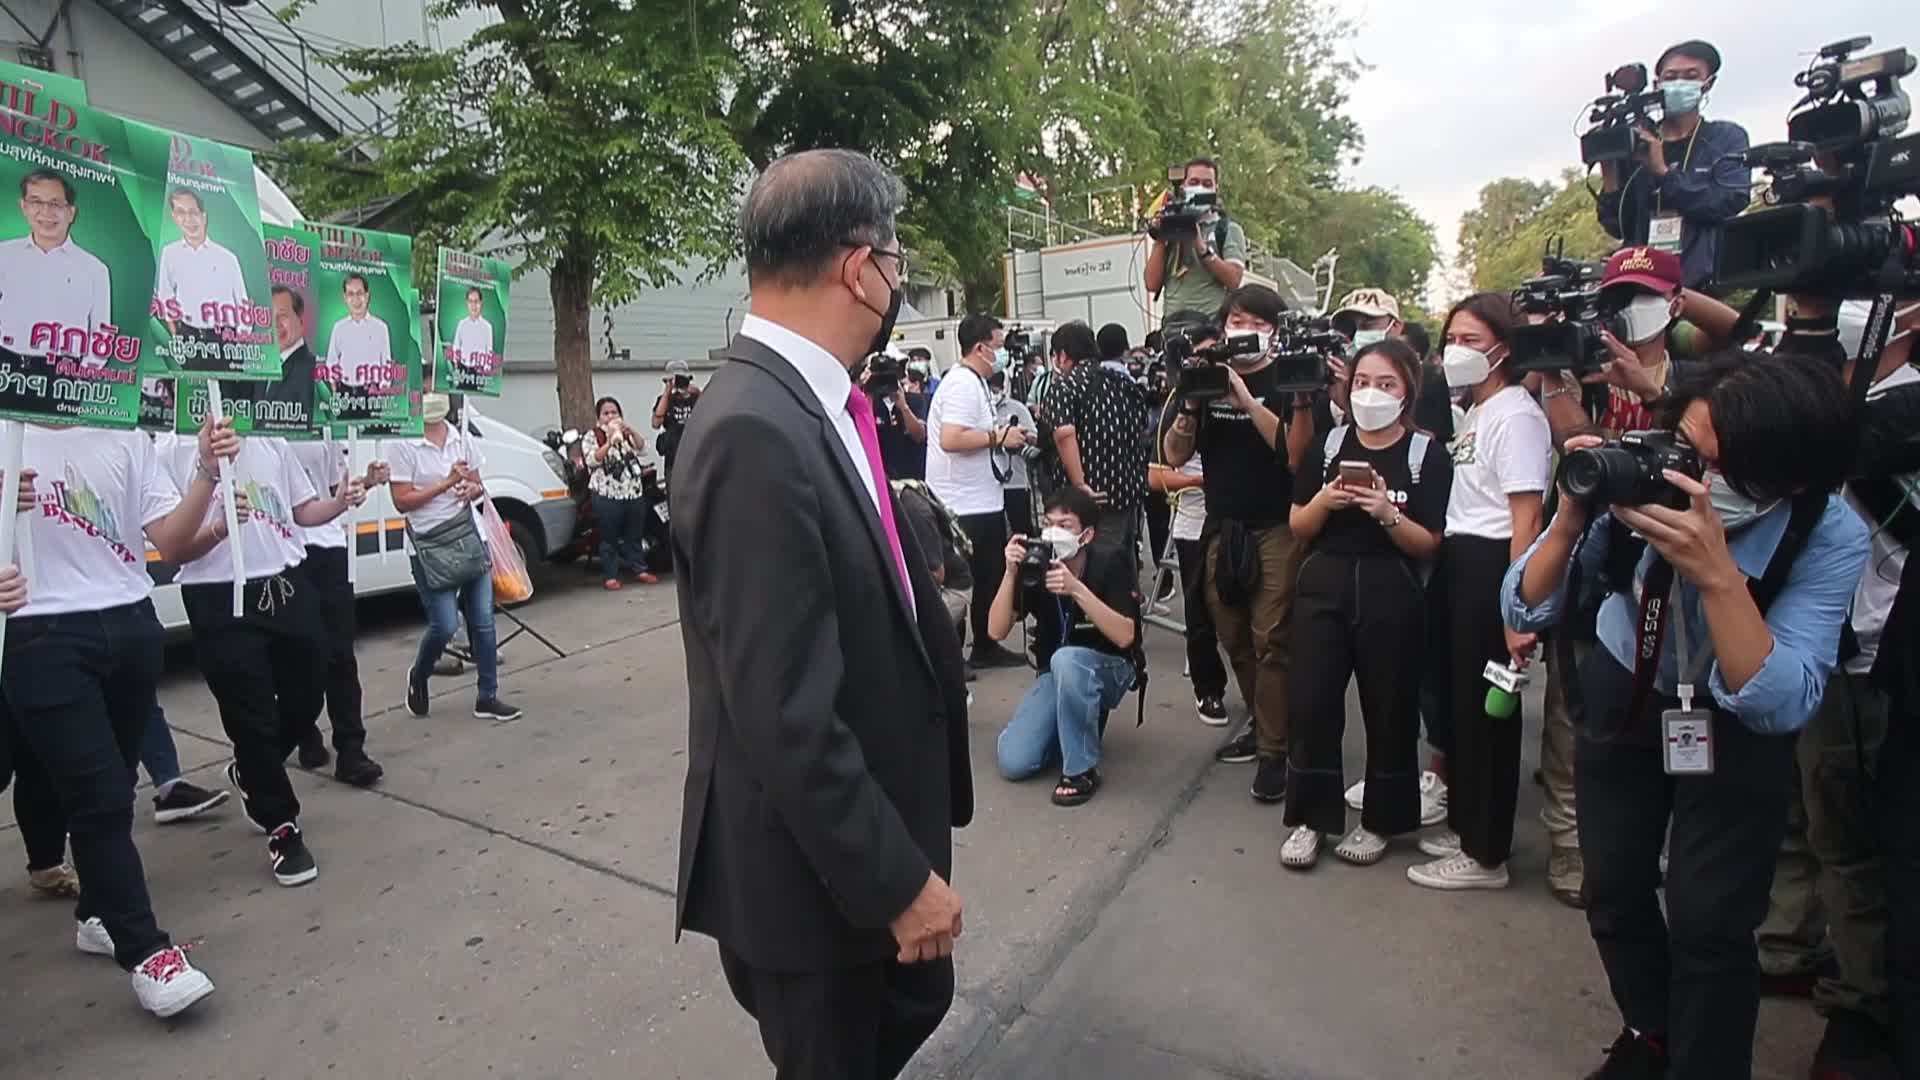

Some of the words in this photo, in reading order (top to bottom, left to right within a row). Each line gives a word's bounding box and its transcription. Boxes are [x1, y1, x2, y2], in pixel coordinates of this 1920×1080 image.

[0, 80, 79, 131] ILD
[0, 110, 111, 165] NGKOK
[0, 142, 117, 186] มสุขให้คนกรุงเทพฯ
[1862, 293, 1893, 358] Panasonic
[52, 378, 117, 405] กทม.
[186, 388, 252, 425] ผู้าฯ
[255, 400, 308, 422] กทม.
[1644, 598, 1661, 632] EOS
